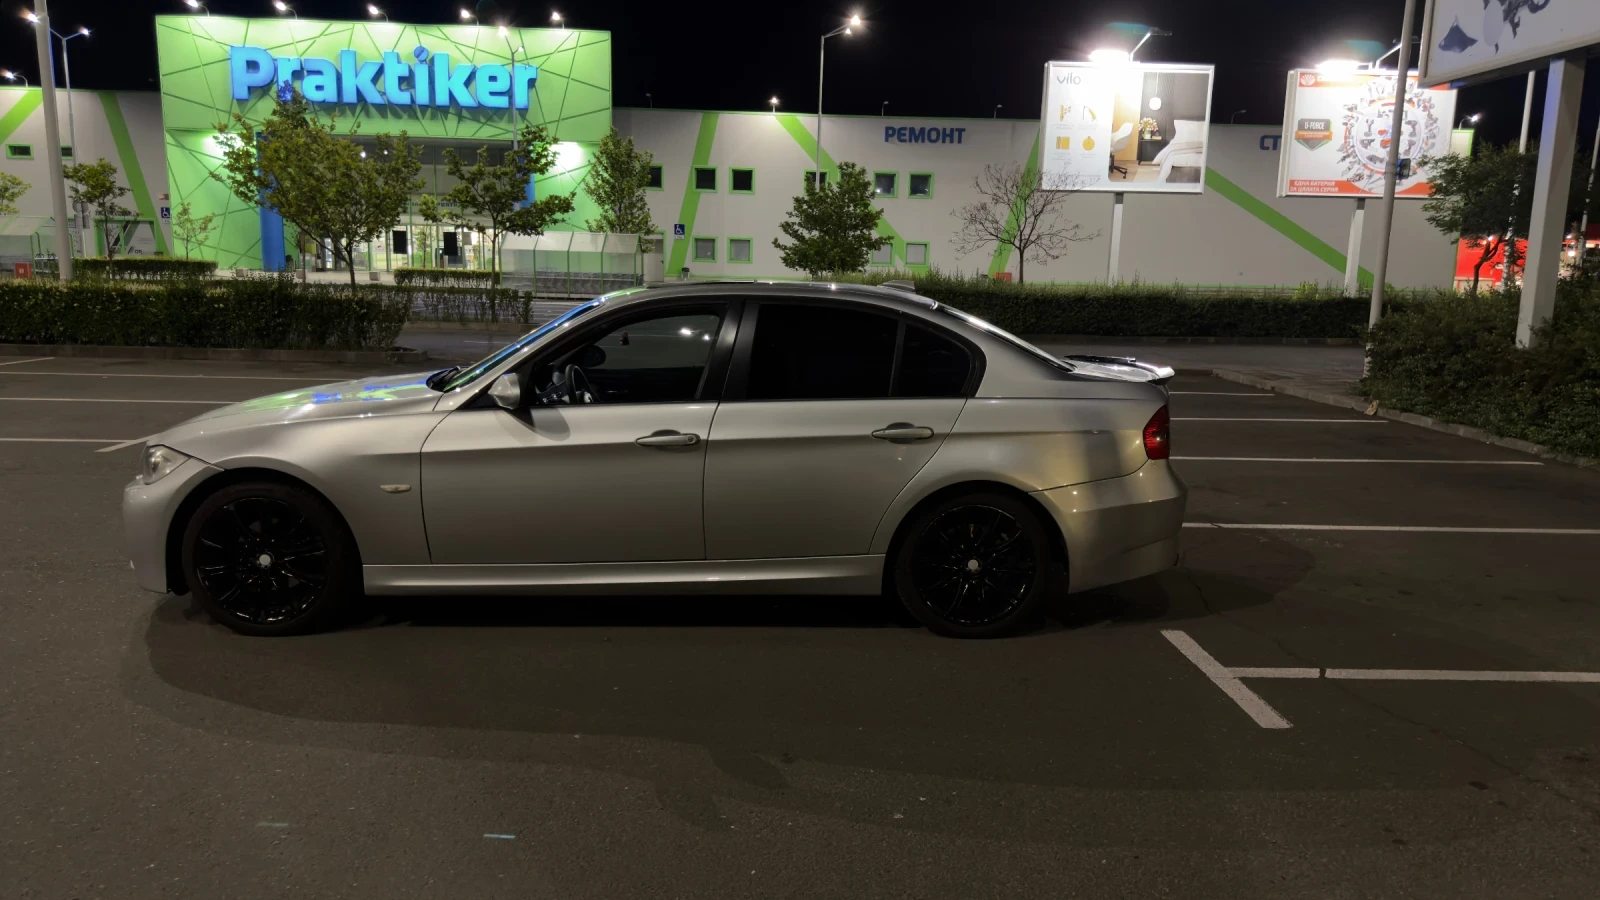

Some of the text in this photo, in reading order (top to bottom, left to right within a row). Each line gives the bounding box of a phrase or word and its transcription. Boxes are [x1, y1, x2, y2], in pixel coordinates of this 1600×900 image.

[230, 45, 537, 109] Praktiker
[1056, 72, 1082, 85] vilo
[1304, 121, 1325, 130] U-FORCE
[884, 126, 966, 144] РЕМОНТ
